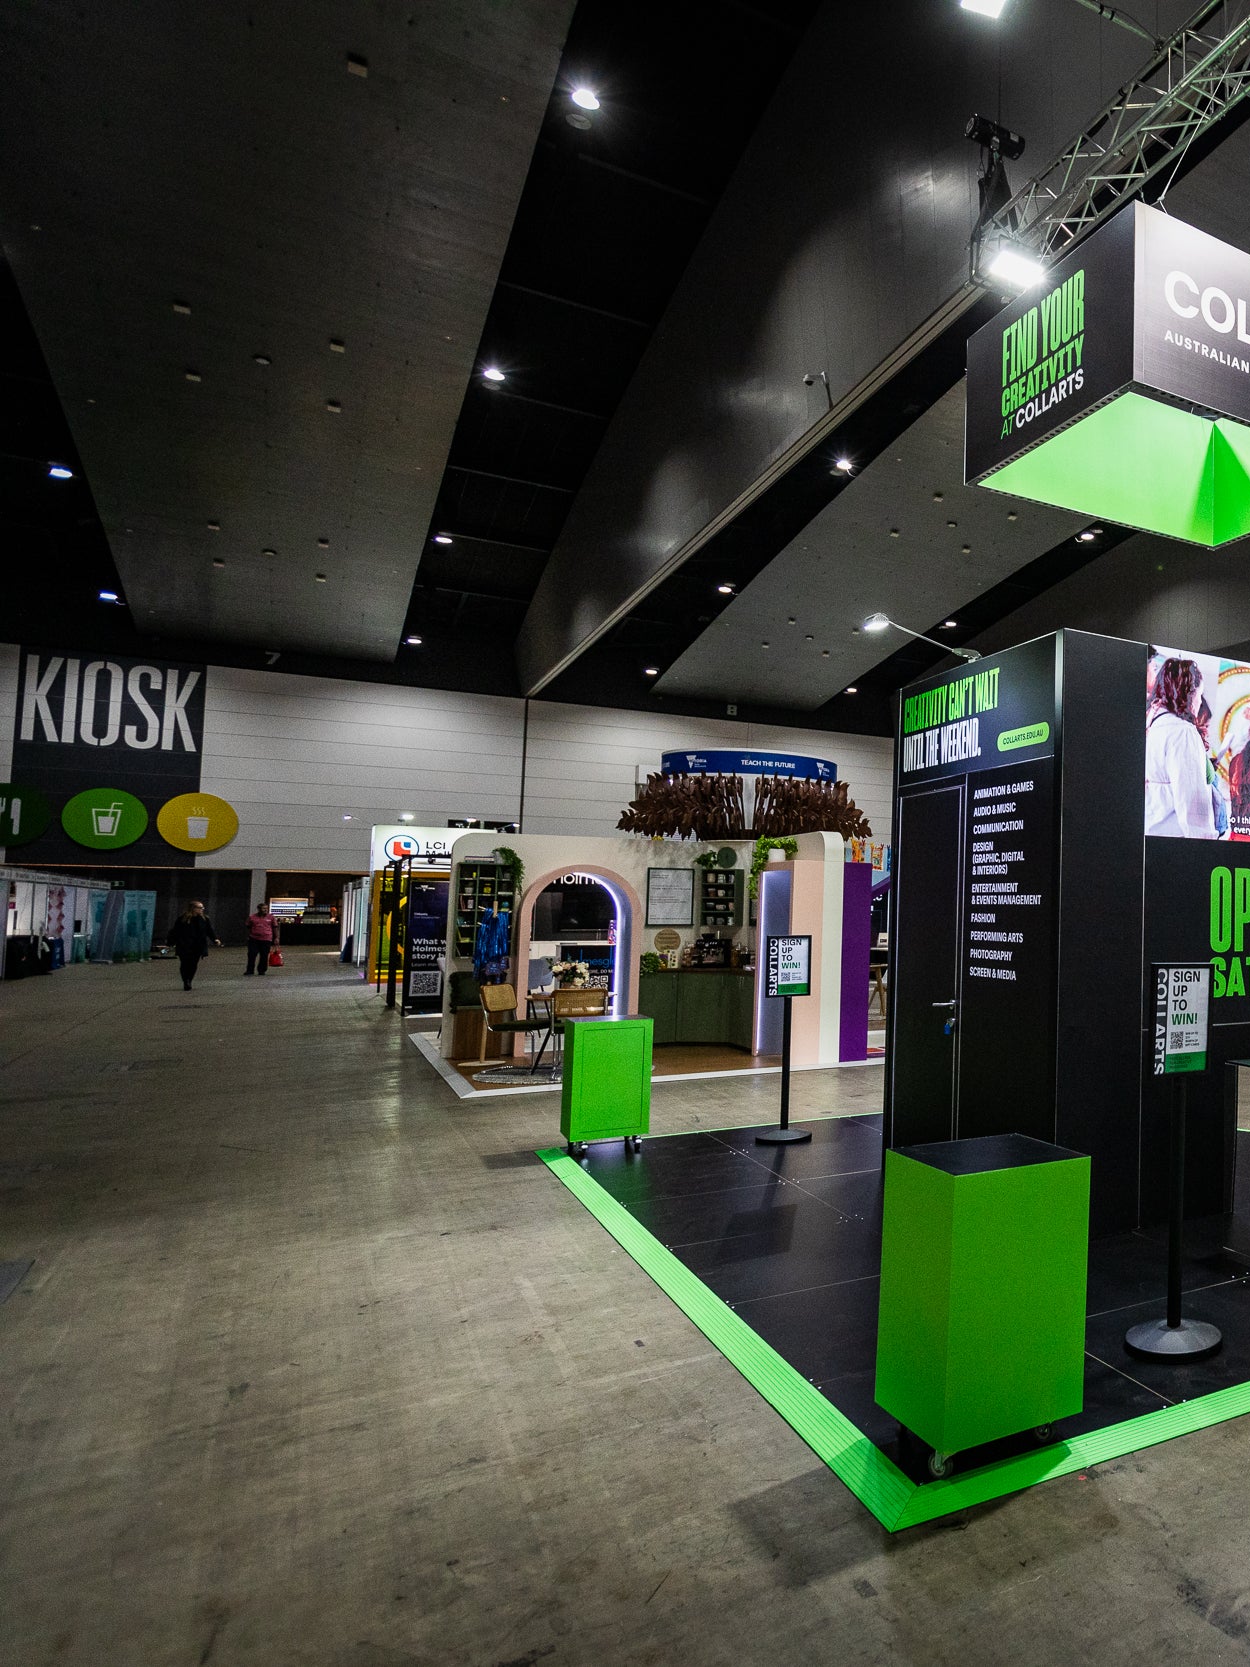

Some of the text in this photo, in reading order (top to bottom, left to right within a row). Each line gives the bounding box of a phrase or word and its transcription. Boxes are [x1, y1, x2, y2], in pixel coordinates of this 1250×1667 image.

[1003, 270, 1085, 386] FIND YOUR
[1165, 330, 1250, 375] AUSTRALIAN
[1001, 334, 1084, 416] CREATIVITY
[1001, 369, 1084, 440] AT COLLARTS
[21, 654, 201, 752] KIOSK
[904, 667, 1000, 734] CREATIVITY CAN'T WAIT
[1003, 729, 1044, 745] COLLARTS.EDU.AU
[904, 717, 981, 773] UNTIL THE WEEKEND.
[775, 761, 796, 769] FUTURE
[974, 781, 1034, 800] ANIMATION & GAMES
[974, 802, 1016, 817] AUDIO & MUSIC
[973, 820, 1024, 834] COMMUNICATION
[426, 842, 446, 850] LCI
[973, 841, 994, 852] DESIGN
[972, 851, 1025, 865] (GRAPHIC, DIGITAL
[972, 864, 1008, 875] & INTERIORS)
[972, 883, 1019, 893] ENTERTAINMENT
[972, 895, 1042, 905] & EVENTS MANAGEMENT
[971, 913, 996, 923] FASHION
[971, 931, 1024, 943] PERFORMING ARTS
[970, 949, 1012, 961] PHOTOGRAPHY
[970, 967, 1016, 981] SCREEN & MEDIA
[1173, 971, 1201, 983] SIGN
[1173, 985, 1188, 997] UP
[1172, 999, 1188, 1011] TO
[1172, 1013, 1198, 1025] WIN!
